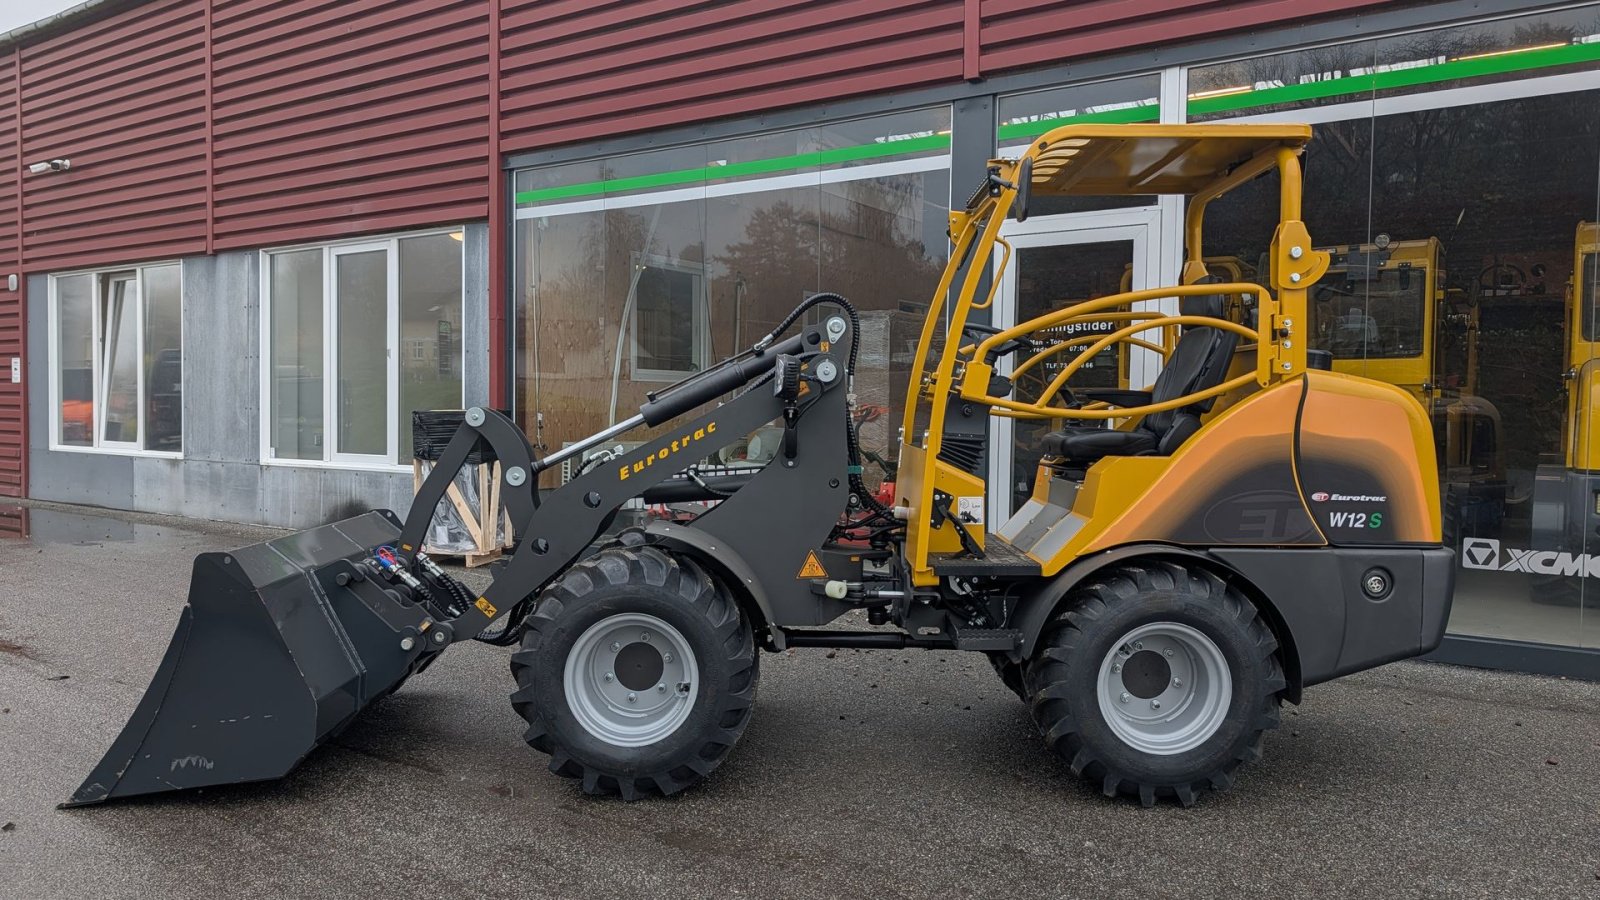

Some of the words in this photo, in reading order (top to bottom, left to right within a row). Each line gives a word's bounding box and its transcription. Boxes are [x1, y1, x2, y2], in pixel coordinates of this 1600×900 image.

[619, 421, 717, 481] Eurotrac
[1330, 493, 1387, 502] Eurotrac
[1329, 511, 1367, 528] W12
[1368, 512, 1383, 528] S
